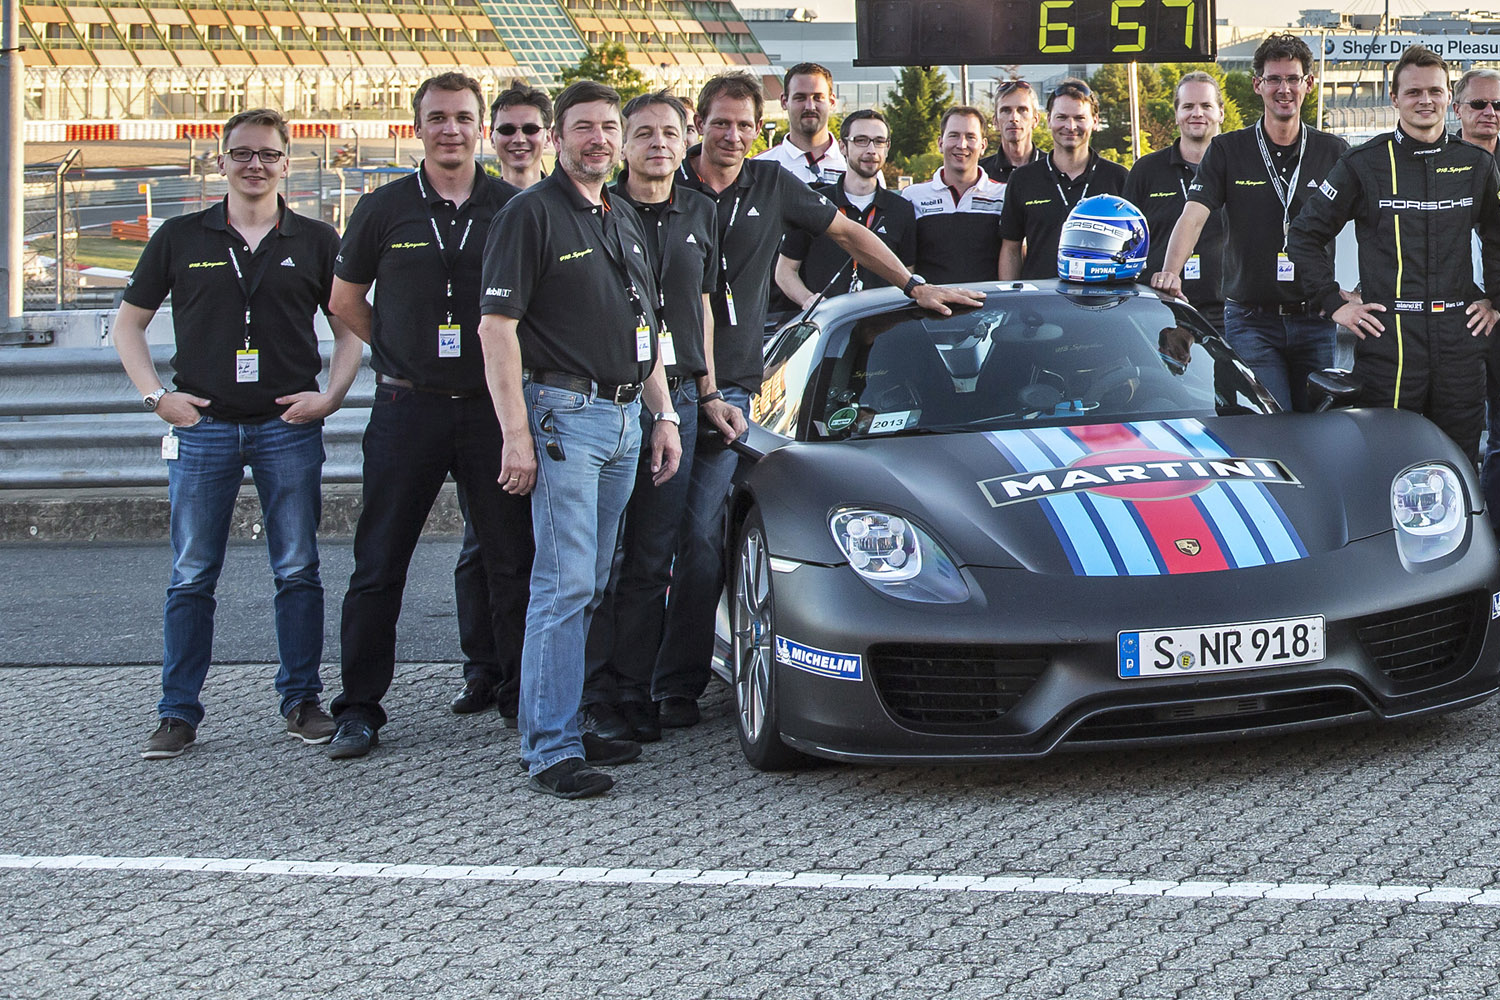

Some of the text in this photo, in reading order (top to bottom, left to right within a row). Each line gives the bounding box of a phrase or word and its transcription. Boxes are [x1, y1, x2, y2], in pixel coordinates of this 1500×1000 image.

[1038, 0, 1195, 53] 6 57
[1342, 39, 1387, 54] Sheer
[1390, 40, 1443, 57] Drng
[1378, 197, 1473, 211] PORSCHE
[1064, 221, 1124, 238] ORSCHE
[873, 418, 904, 429] 2013
[1003, 458, 1281, 497] MARTINI
[1153, 623, 1311, 670] S NR 918
[791, 647, 858, 674] MICHELIN
